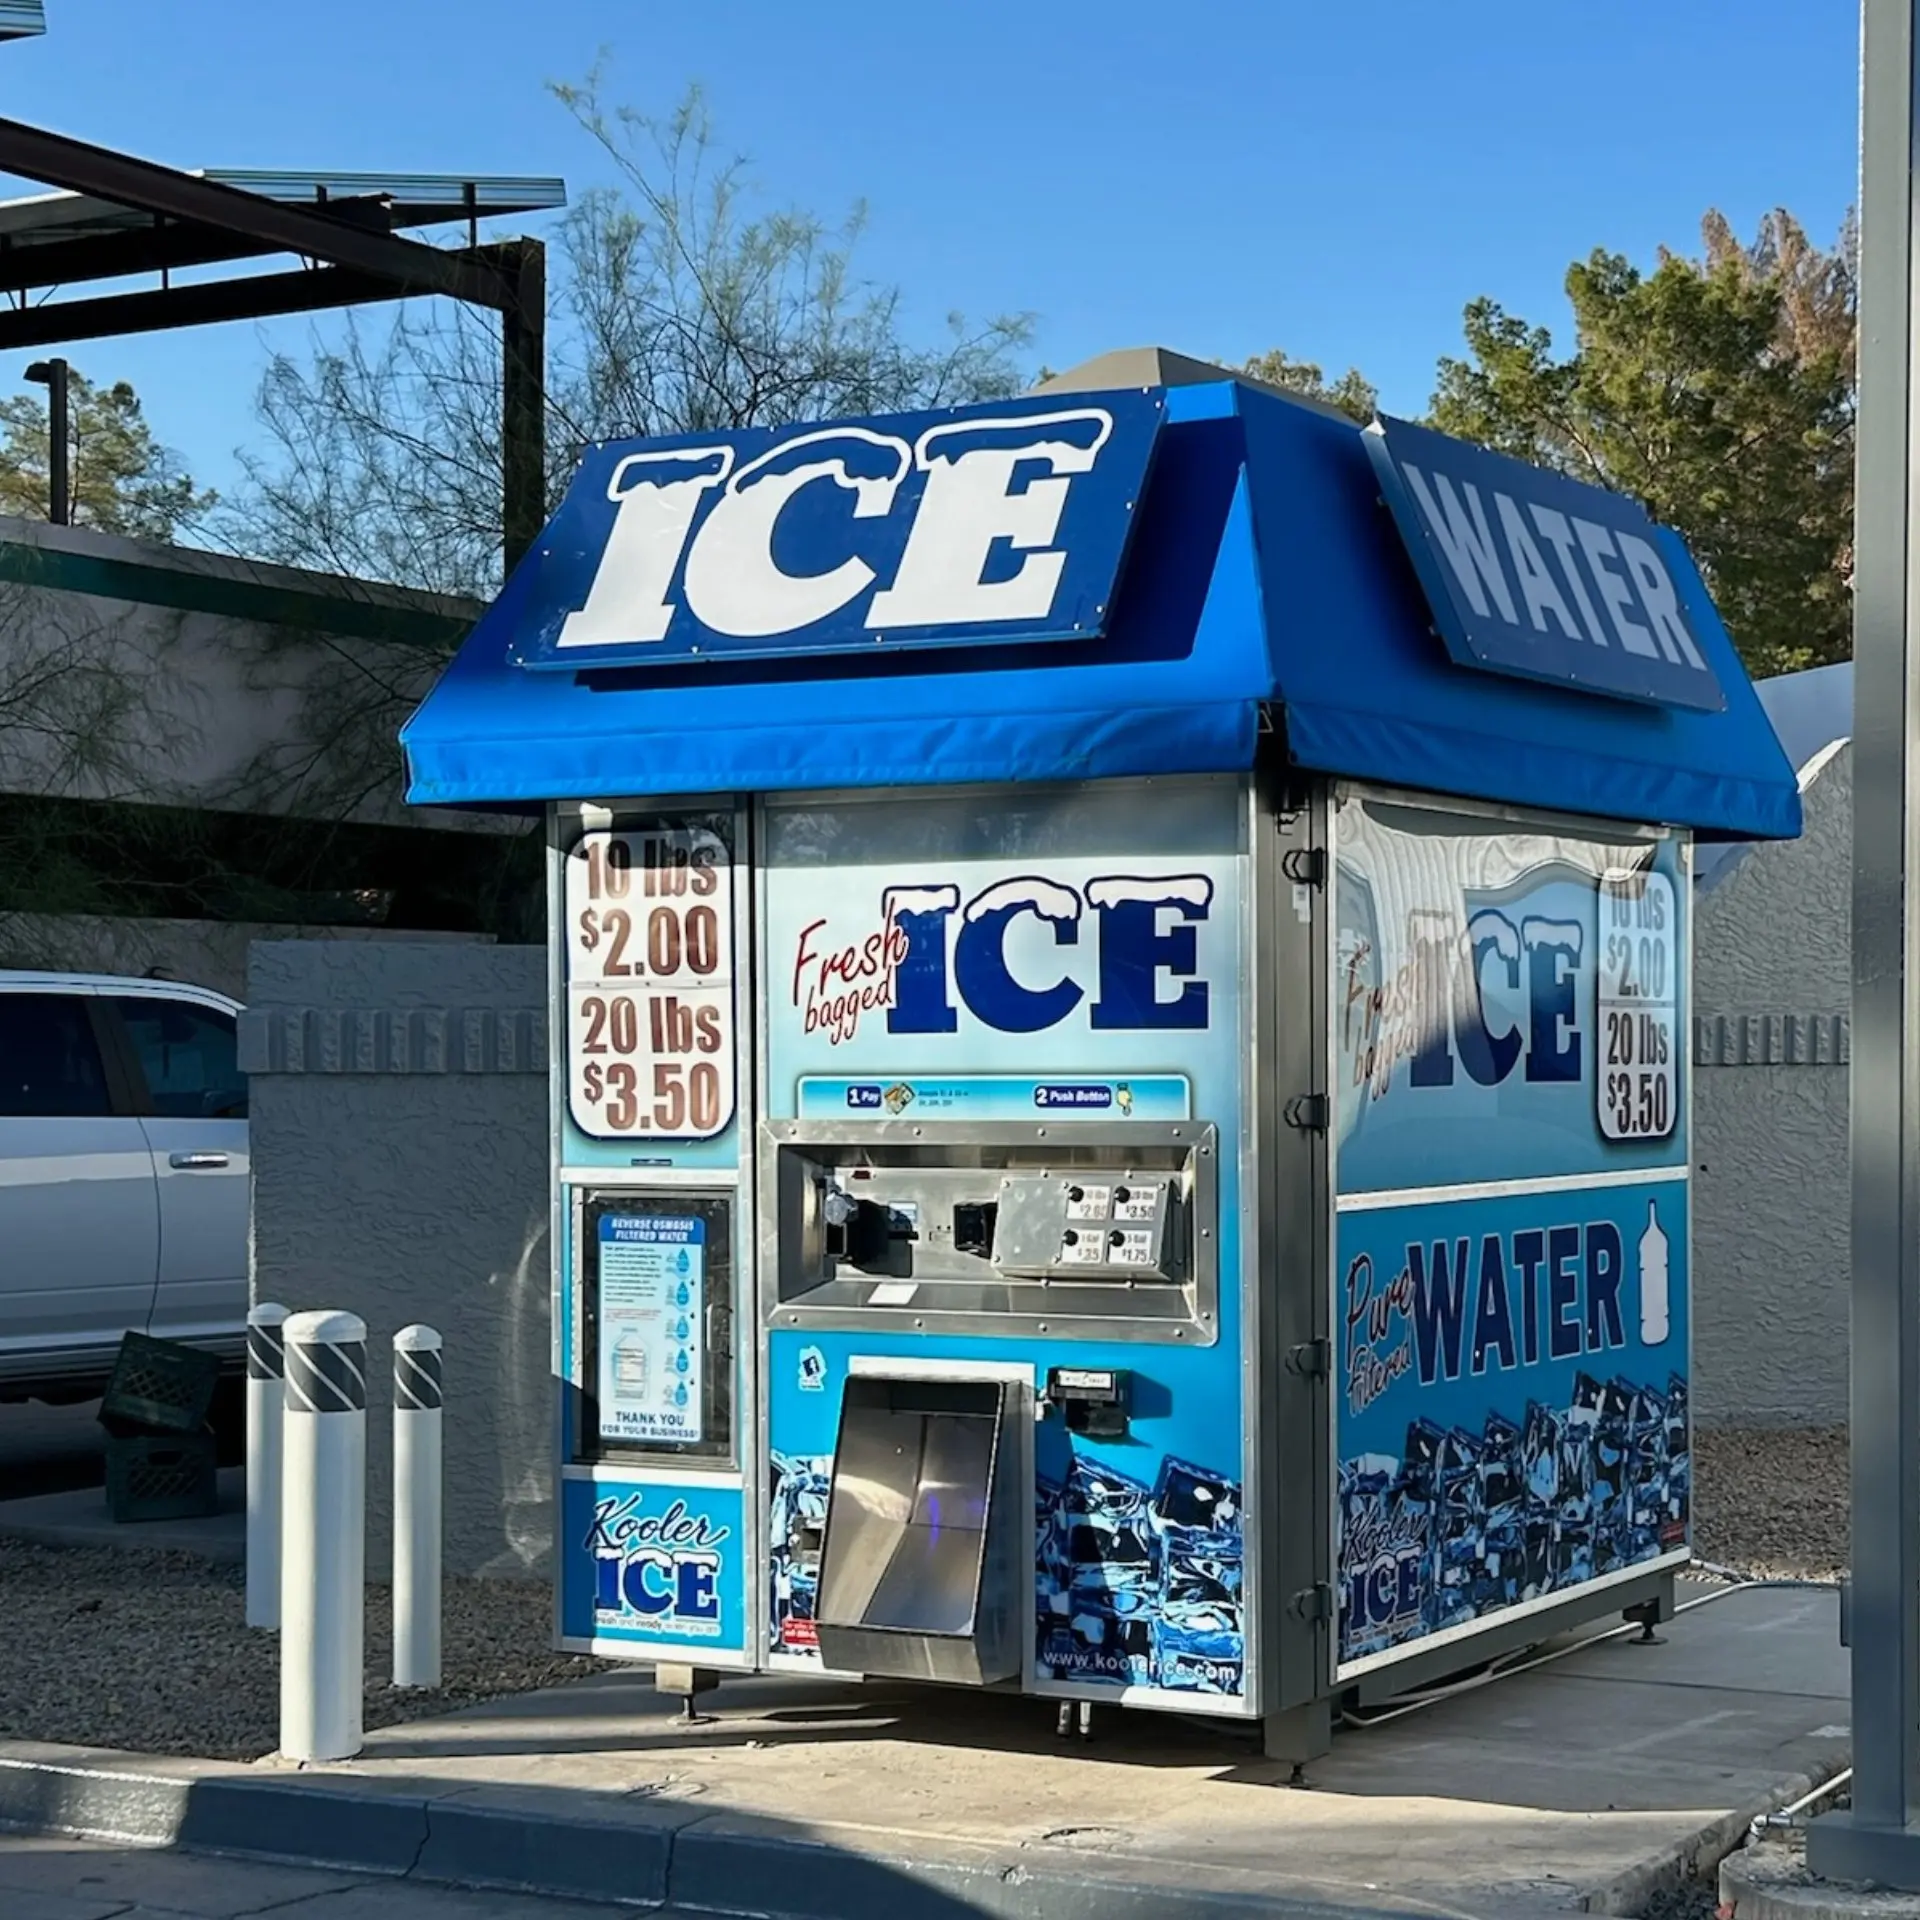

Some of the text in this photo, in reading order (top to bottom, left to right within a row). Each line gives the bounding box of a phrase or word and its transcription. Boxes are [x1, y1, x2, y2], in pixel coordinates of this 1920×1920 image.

[556, 408, 1113, 648] ICE
[1400, 461, 1708, 672] WATER
[583, 836, 718, 899] 10 lbs
[580, 904, 719, 977] $2.00
[792, 897, 908, 1007] Fresh
[882, 874, 1214, 1034] ICE
[1606, 932, 1666, 998] $2.00
[580, 996, 722, 1054] 20 lbs
[804, 964, 891, 1046] bagged
[1408, 907, 1584, 1088] ICE
[1607, 1012, 1668, 1067] 20 lbs
[582, 1060, 720, 1130] $3.50
[849, 1088, 881, 1105] 1 Pay
[1036, 1088, 1048, 1104] 2
[1050, 1090, 1075, 1103] Push
[1606, 1073, 1668, 1135] $3.50
[615, 1229, 688, 1243] FILTERED WATER
[1405, 1220, 1625, 1386] WATER
[602, 1424, 621, 1433] FOR
[623, 1425, 647, 1435] YOUR
[615, 1411, 686, 1427] THANK YOU
[584, 1493, 729, 1548] Kooler
[593, 1547, 720, 1620] ICE
[1349, 1543, 1424, 1630] ICE
[1043, 1650, 1237, 1682] www.koolerice.com
